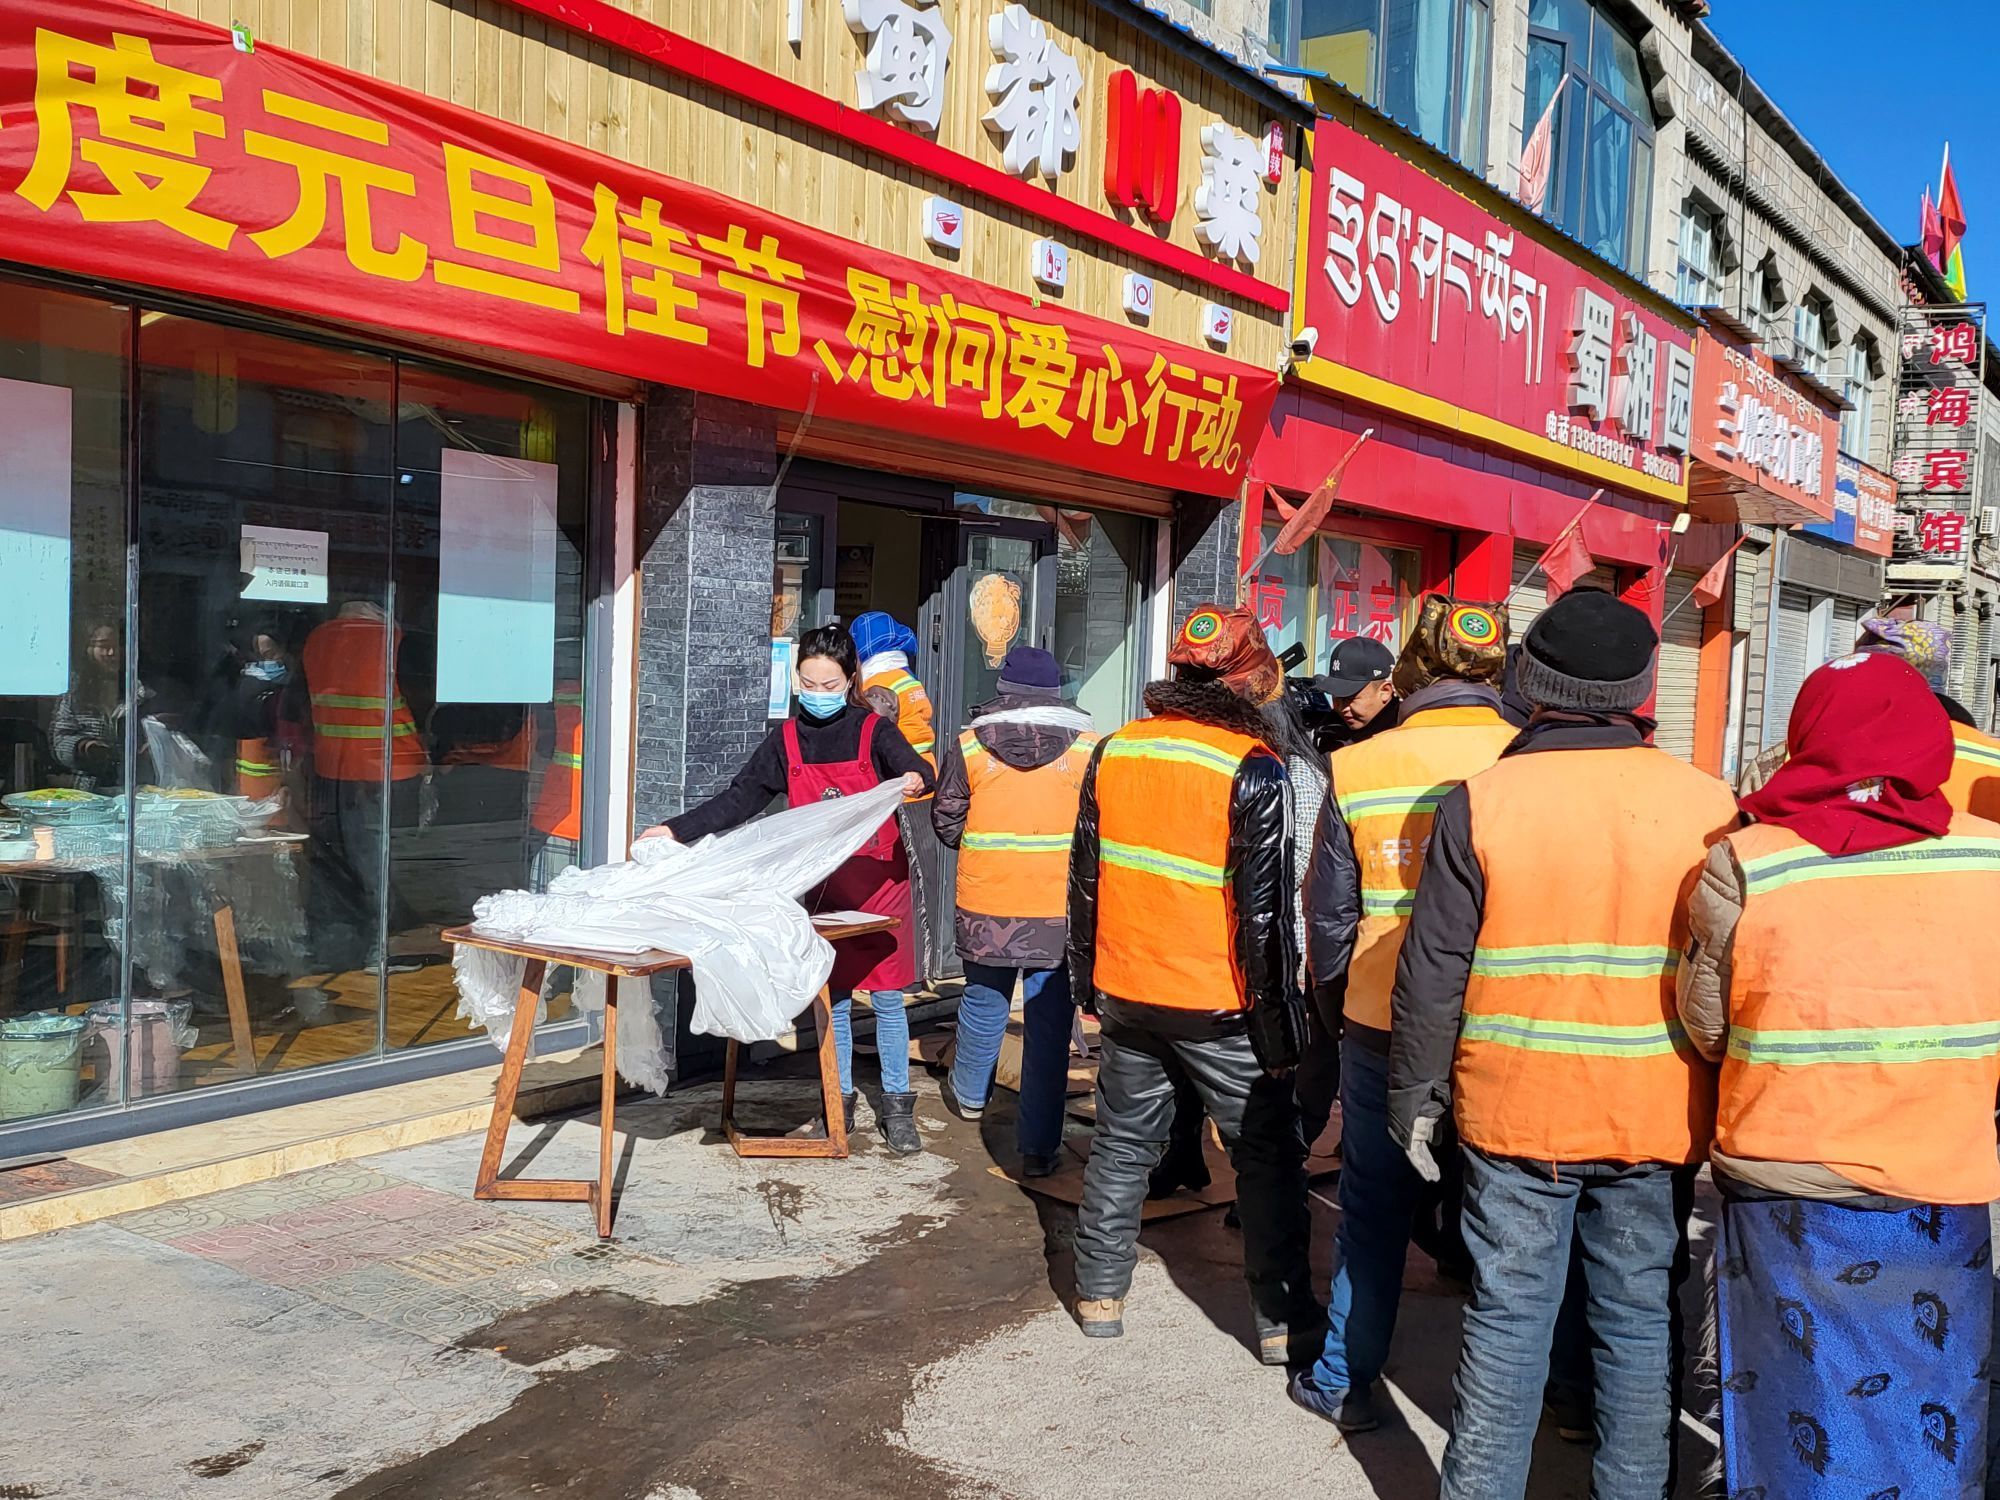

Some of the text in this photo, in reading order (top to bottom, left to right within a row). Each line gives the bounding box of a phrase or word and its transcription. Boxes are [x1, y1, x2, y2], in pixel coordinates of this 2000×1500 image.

[1269, 126, 1283, 177] 麻辣
[1568, 287, 1695, 455] 蜀湘园
[1545, 410, 1570, 445] 电话
[1920, 322, 1978, 554] 鸿海宾馆
